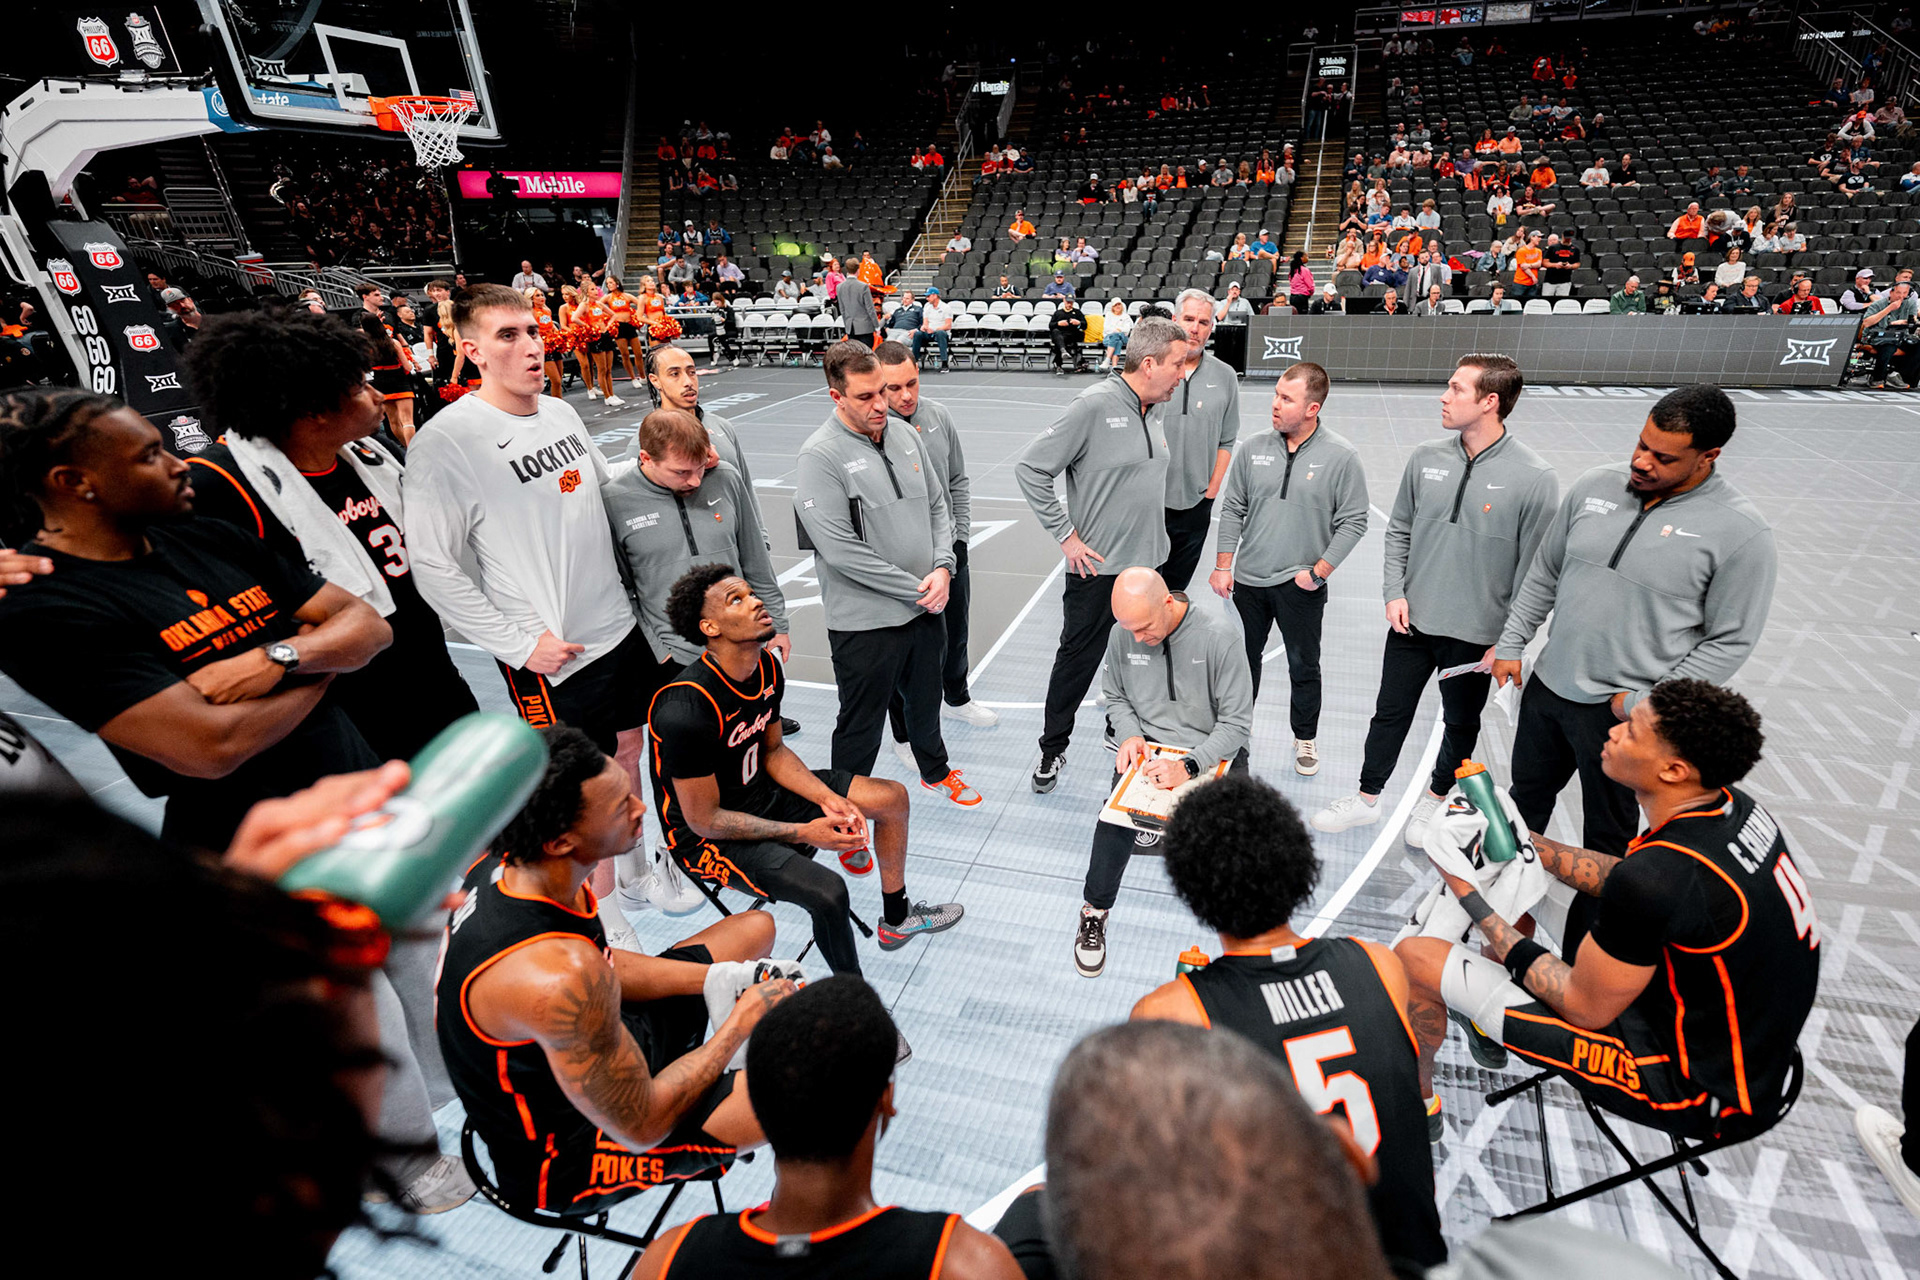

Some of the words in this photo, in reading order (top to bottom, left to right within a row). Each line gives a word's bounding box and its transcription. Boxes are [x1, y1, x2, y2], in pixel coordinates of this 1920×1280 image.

[90, 38, 111, 56] 66
[1318, 68, 1345, 77] CENTER
[256, 92, 290, 106] tate
[522, 175, 586, 194] Mobile
[95, 253, 116, 264] 66
[58, 273, 75, 288] 66
[100, 284, 141, 303] XII
[71, 305, 98, 335] GO
[85, 336, 111, 365] GO
[134, 336, 153, 347] 66
[1263, 335, 1303, 361] XII
[1780, 338, 1838, 366] XII
[93, 366, 118, 395] GO.
[145, 372, 182, 393] XII
[1524, 384, 1770, 401] LAGUE
[509, 446, 564, 484] LOCK
[554, 439, 576, 464] IT
[566, 433, 588, 457] IN
[559, 469, 582, 494] OSU
[368, 523, 409, 577] 3
[742, 742, 759, 785] 0
[697, 849, 730, 885] PKES
[1772, 851, 1822, 951] 4
[1259, 969, 1345, 1025] MILLER
[1572, 1037, 1641, 1091] POKES
[1282, 1024, 1382, 1158] 5
[589, 1153, 664, 1186] POKES
